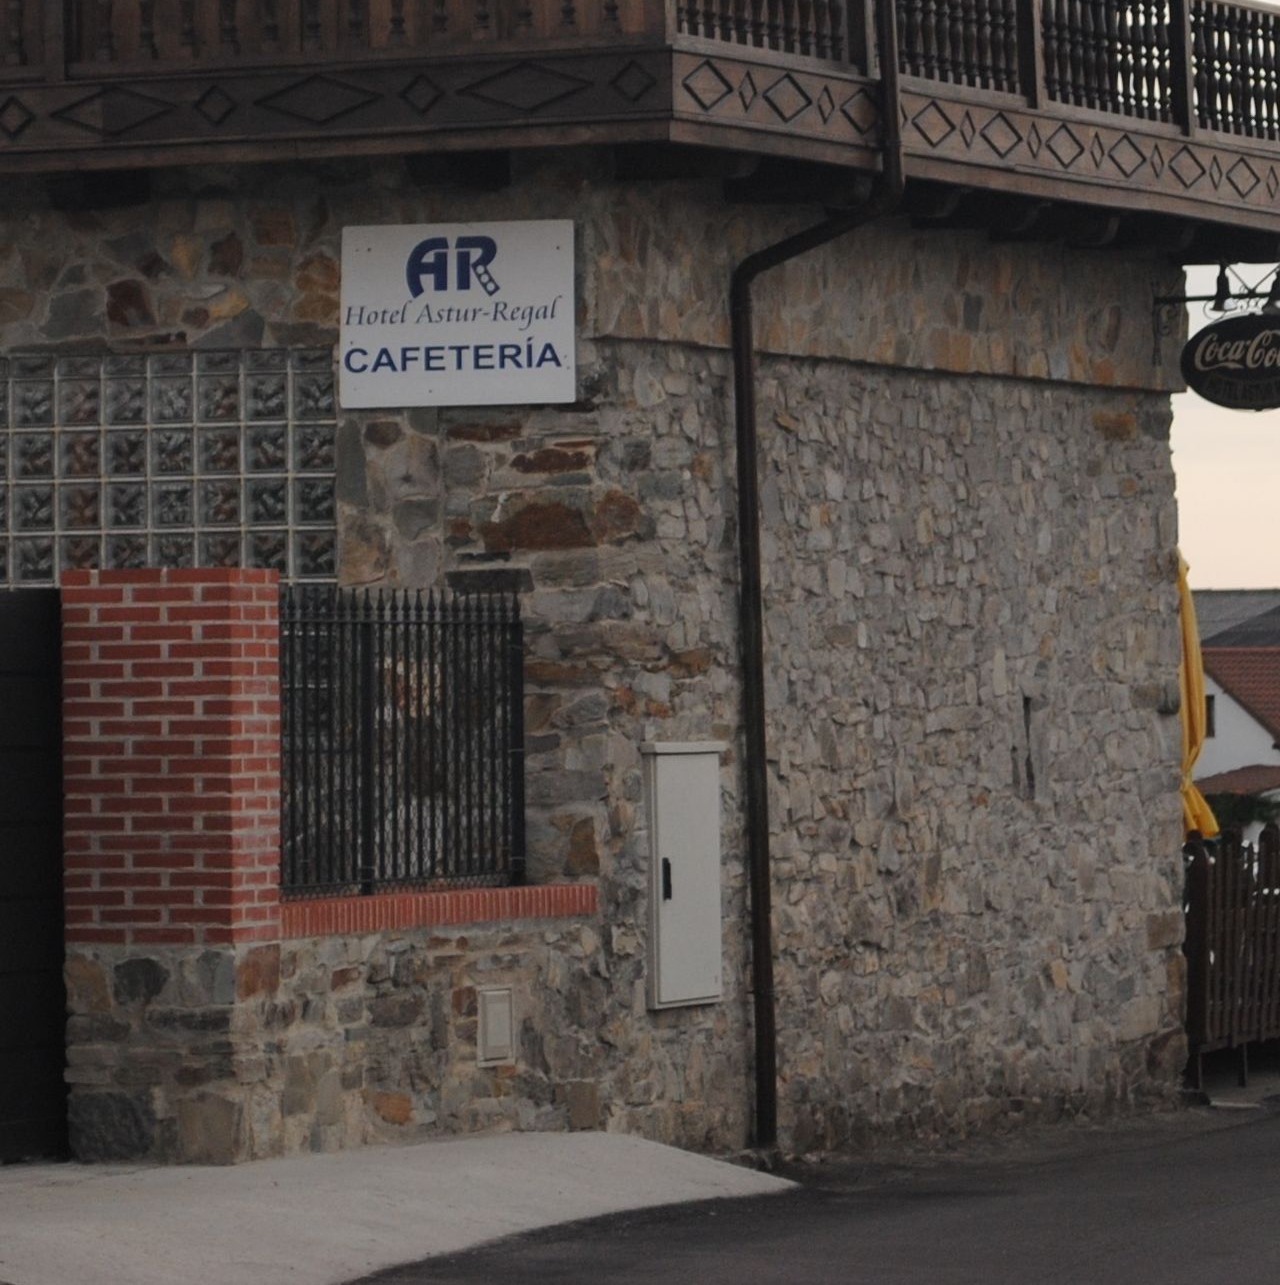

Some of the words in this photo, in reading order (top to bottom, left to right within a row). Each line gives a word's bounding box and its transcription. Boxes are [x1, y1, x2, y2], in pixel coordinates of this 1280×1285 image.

[406, 235, 500, 299] AR
[344, 300, 413, 326] Hotel
[416, 295, 563, 331] Astur-Regal
[344, 337, 562, 373] CAFETERÍA
